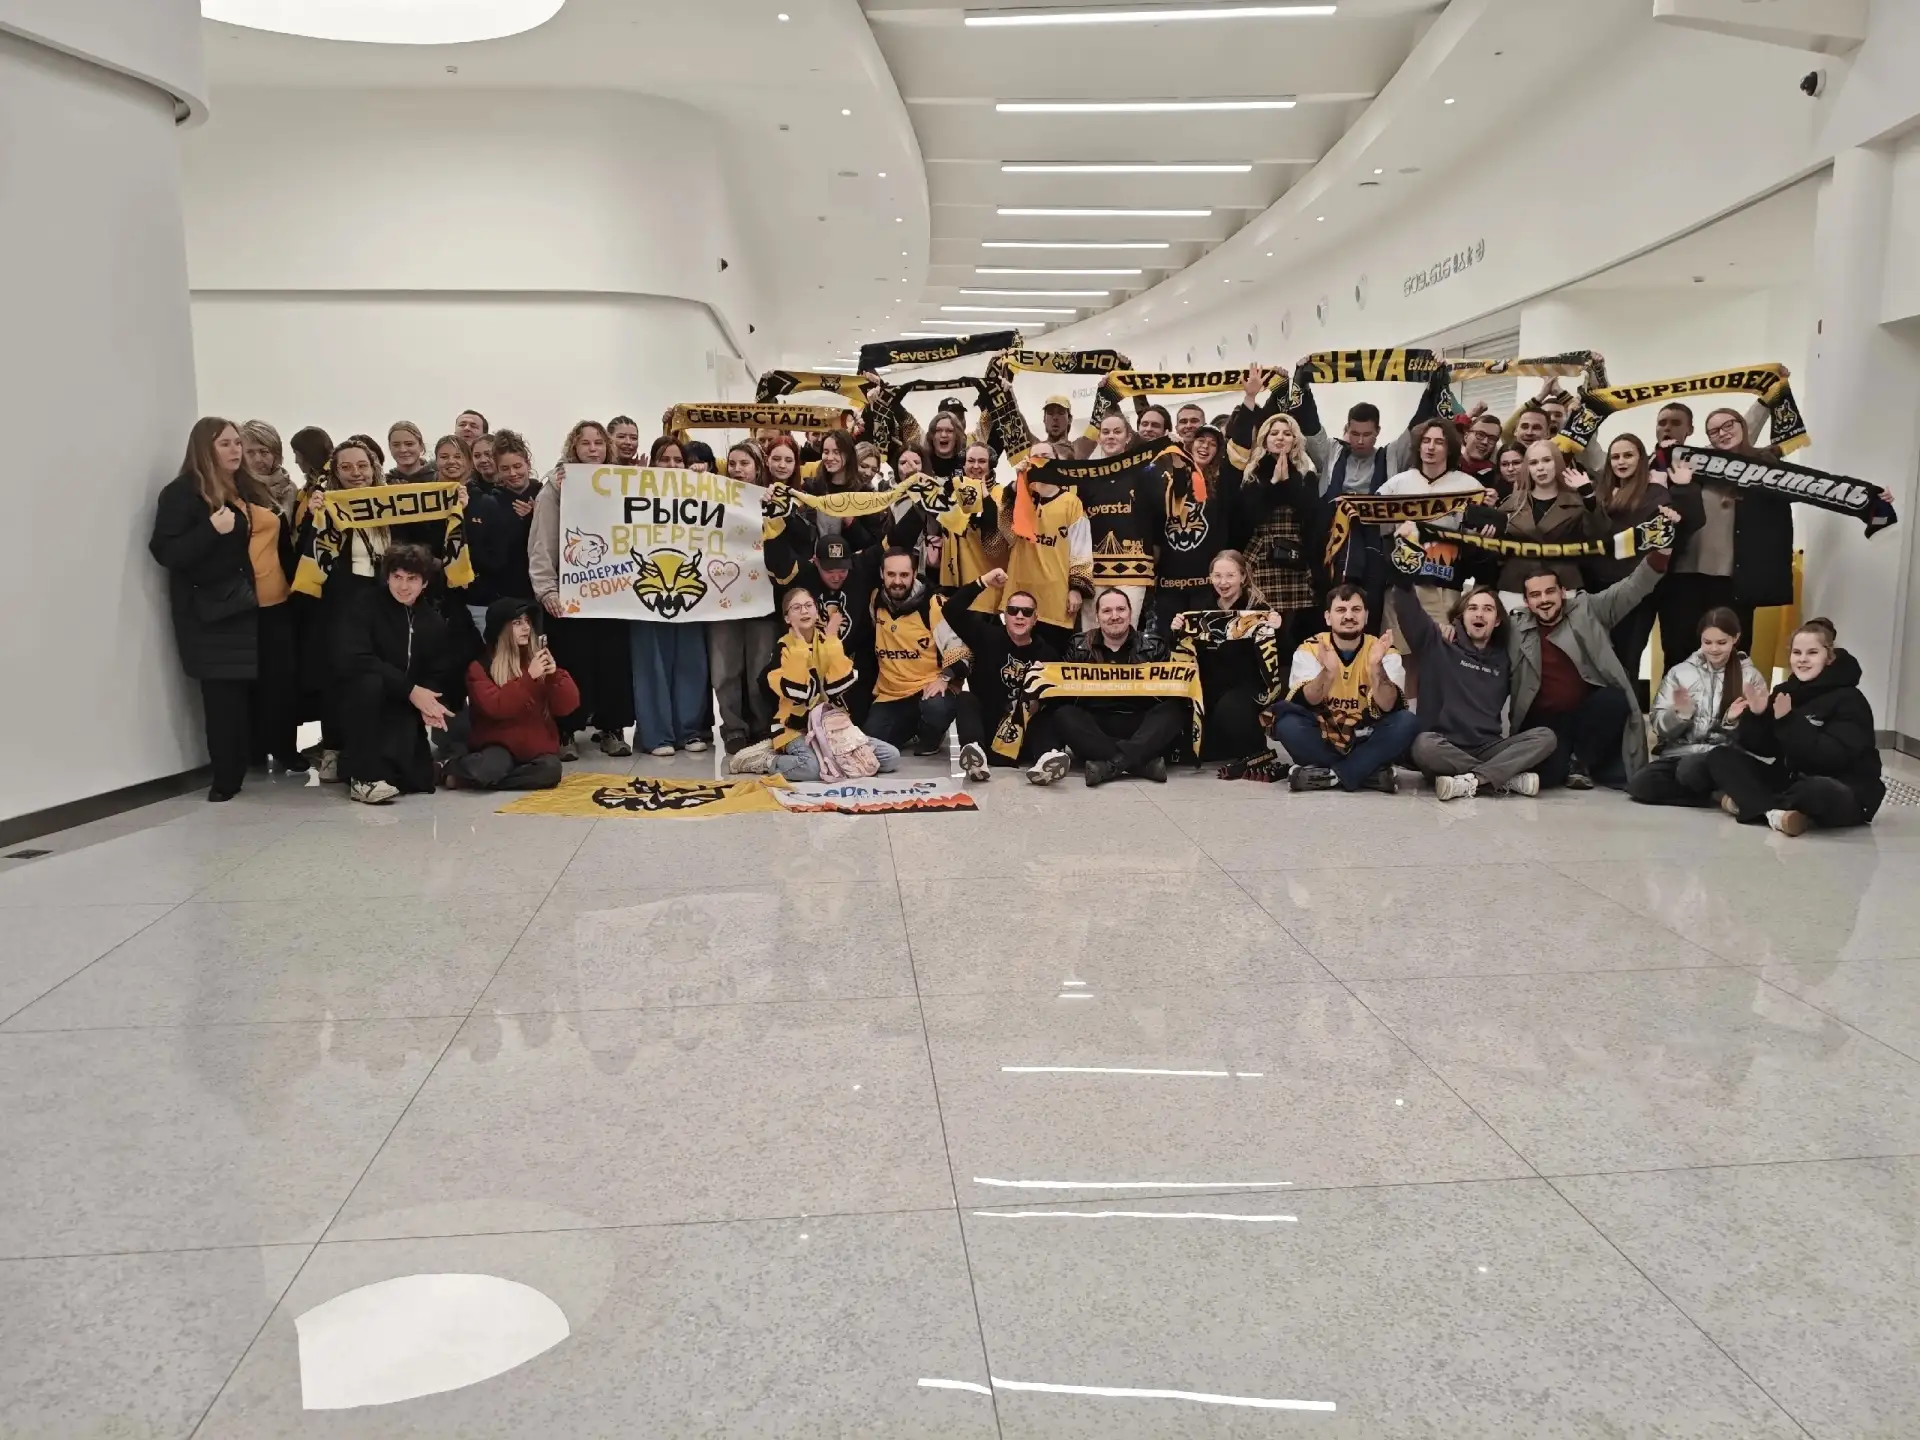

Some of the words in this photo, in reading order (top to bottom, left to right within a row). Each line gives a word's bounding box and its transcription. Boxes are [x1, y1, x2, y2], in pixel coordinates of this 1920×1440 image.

[890, 344, 958, 363] Severstal
[1311, 349, 1406, 384] SEVA
[1611, 370, 1780, 404] ЧЕРЕПОВЕЦ
[686, 409, 822, 427] СЕВЕРСТАЛЬ
[591, 467, 746, 508] СТАЛЬНЫЕ
[624, 497, 726, 529] РЫСИ
[562, 561, 634, 585] ПОДДЕРЖАТ
[1160, 576, 1213, 590] Северстал
[580, 576, 633, 599] СВОИХ
[1061, 666, 1145, 681] СТАЛЬНЫЕ
[1149, 666, 1197, 683] РЫСИ
